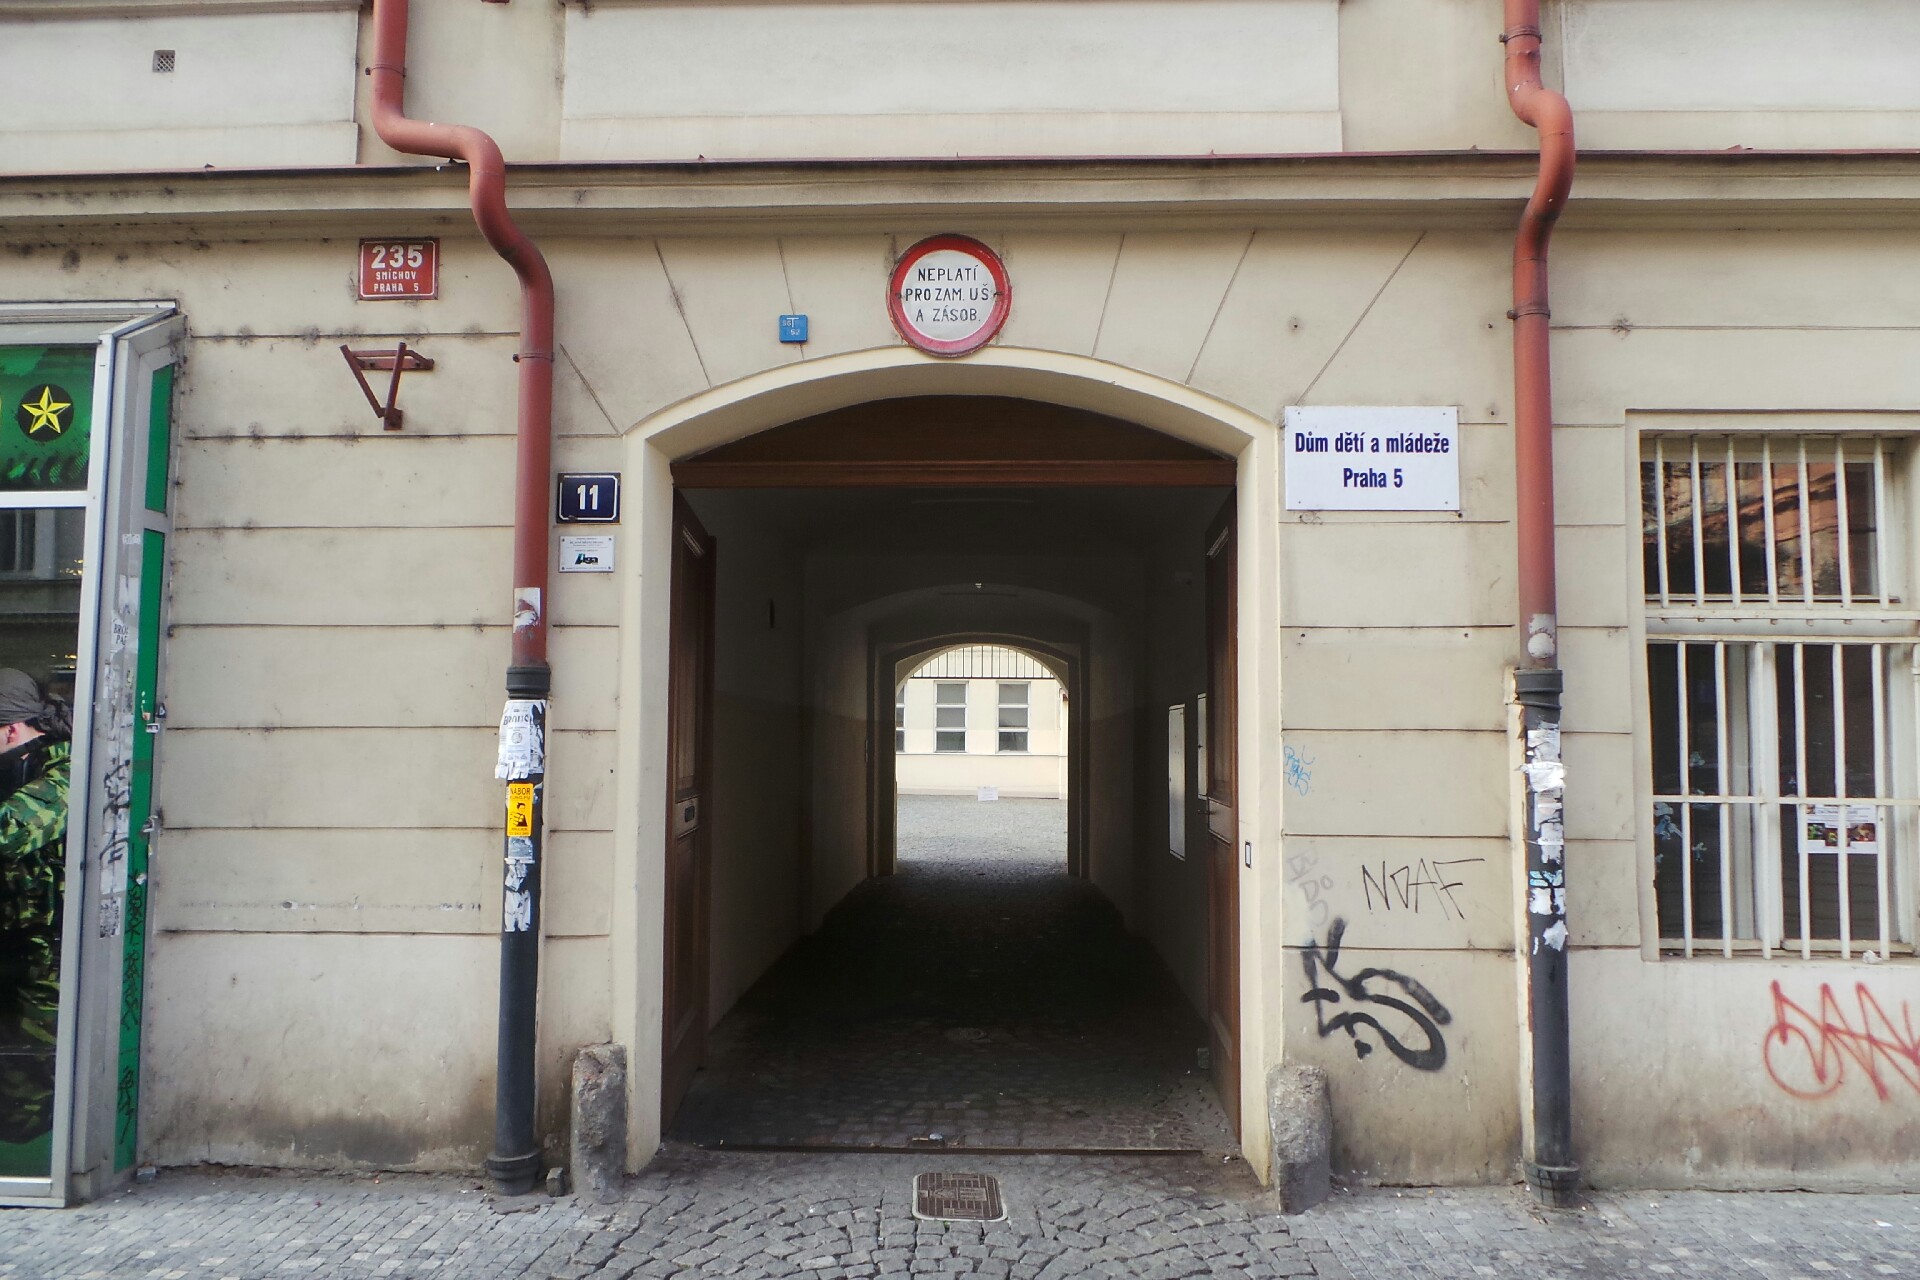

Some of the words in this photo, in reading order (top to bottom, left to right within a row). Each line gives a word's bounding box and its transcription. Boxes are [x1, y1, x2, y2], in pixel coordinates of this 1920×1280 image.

[371, 244, 424, 269] 235
[375, 268, 417, 280] SMÍCHOV
[917, 264, 979, 282] NEPLATÍ
[373, 283, 404, 292] PRAHA
[413, 282, 419, 292] 5
[905, 288, 932, 301] PRO
[915, 308, 924, 322] A
[1294, 431, 1329, 453] Dům
[1334, 431, 1366, 453] dětí
[1370, 436, 1380, 453] a
[1386, 432, 1450, 453] mládeže
[1343, 467, 1387, 488] Praha
[1393, 468, 1403, 488] 5
[577, 484, 599, 510] 11
